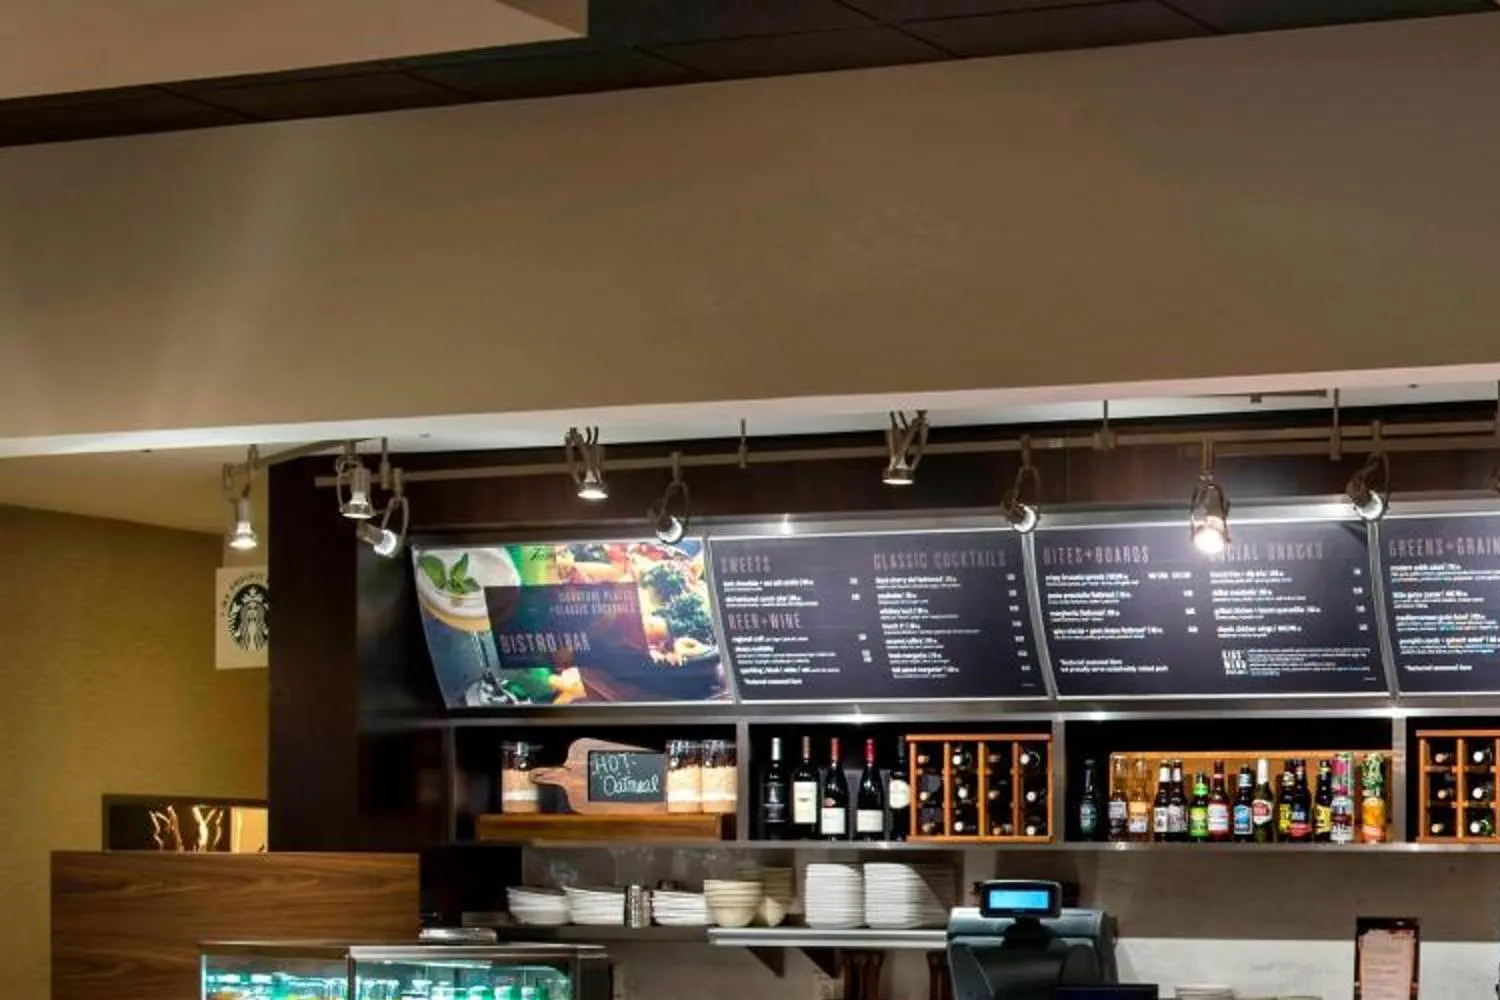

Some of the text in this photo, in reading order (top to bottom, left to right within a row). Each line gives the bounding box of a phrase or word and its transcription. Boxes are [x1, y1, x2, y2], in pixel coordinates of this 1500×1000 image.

[873, 549, 1006, 571] CLASSIC COCKTAILS
[1267, 541, 1324, 561] SNACKS
[500, 632, 557, 654] BISTRO
[603, 774, 661, 796] Oatmeal
